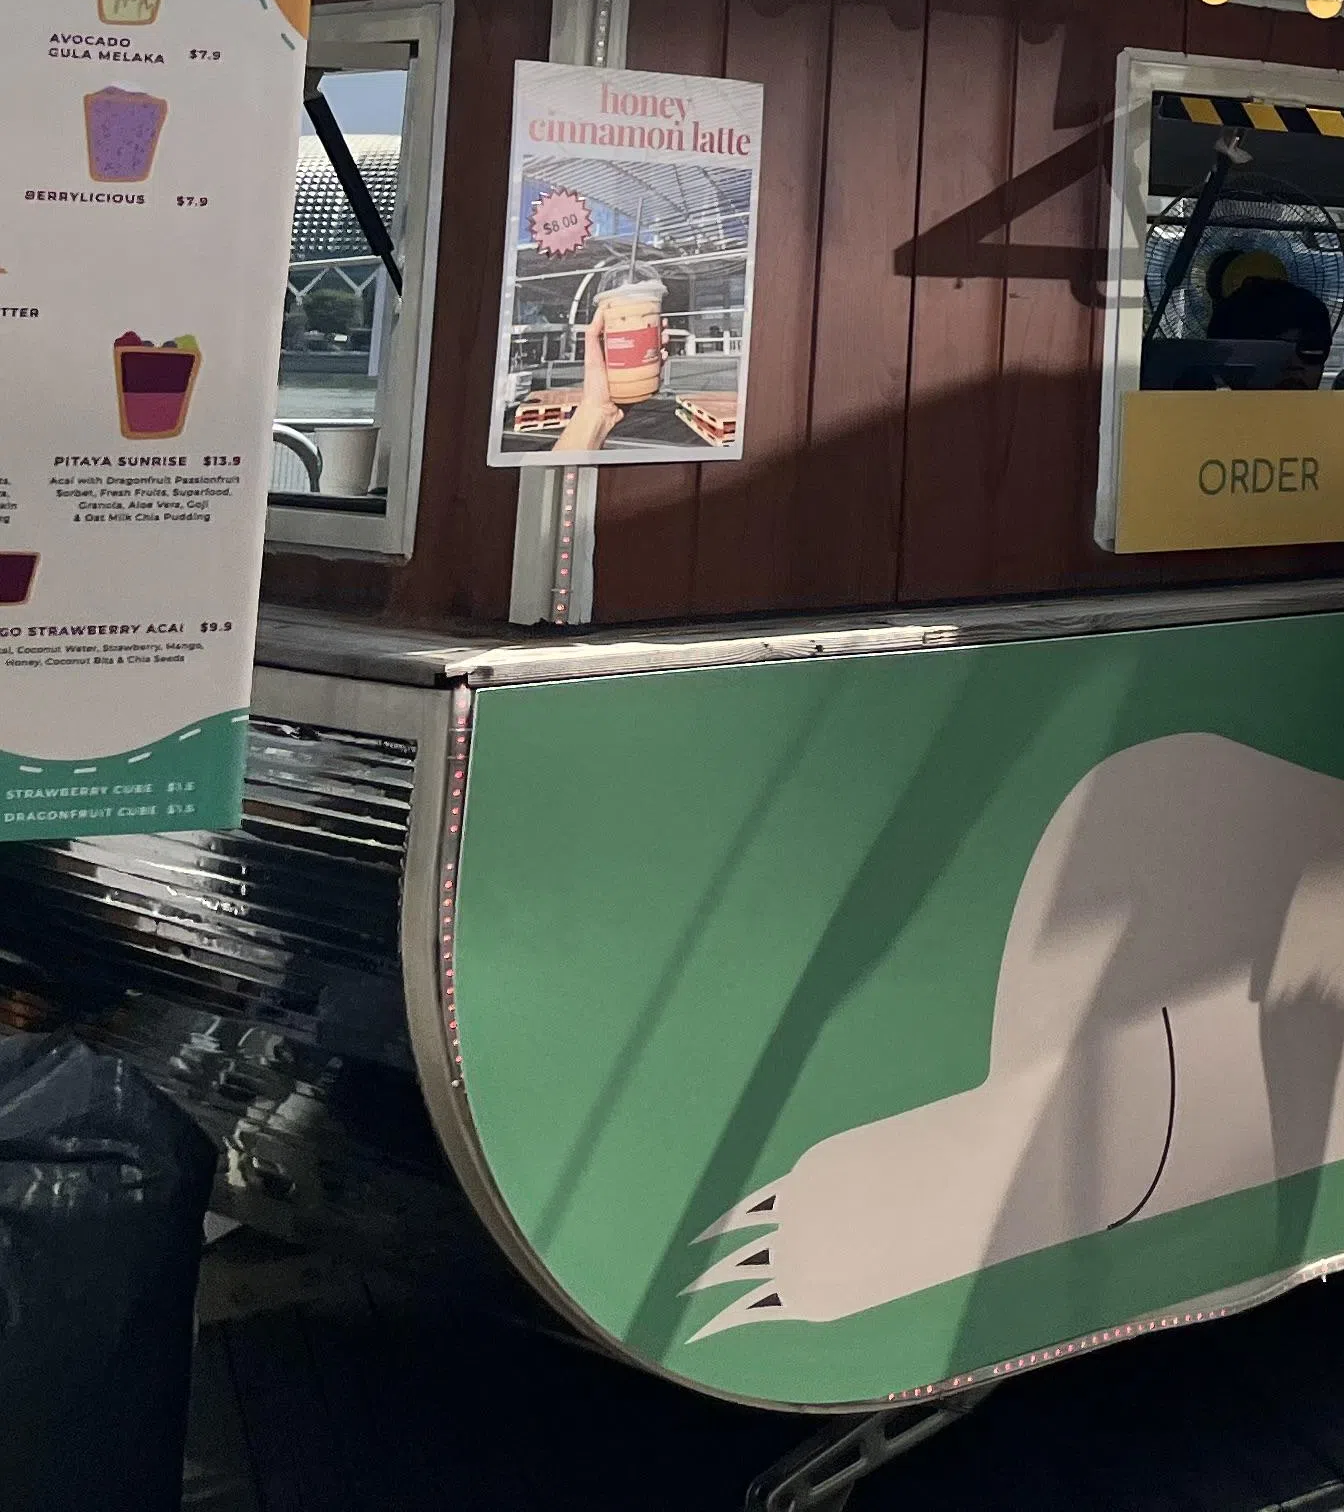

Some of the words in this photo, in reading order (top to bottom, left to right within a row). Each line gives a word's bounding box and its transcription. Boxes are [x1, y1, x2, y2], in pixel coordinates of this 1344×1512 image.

[50, 34, 131, 48] AVOCADO
[48, 48, 92, 60] GULA
[98, 51, 165, 64] MELAKA
[190, 49, 221, 60] $7.9
[600, 82, 694, 123] honey
[528, 110, 686, 151] cinnamon
[692, 122, 752, 156] latte
[25, 190, 145, 204] BERRYLICIOUS
[176, 196, 208, 207] $7.9
[53, 456, 112, 467] PITAYA
[117, 456, 187, 466] SUNRISE
[203, 455, 241, 466] $13.9
[1199, 457, 1319, 495] ORDER
[27, 624, 142, 637] STRAWBERRY
[200, 621, 233, 633] $9.9
[5, 786, 109, 800] STRAWBERRY
